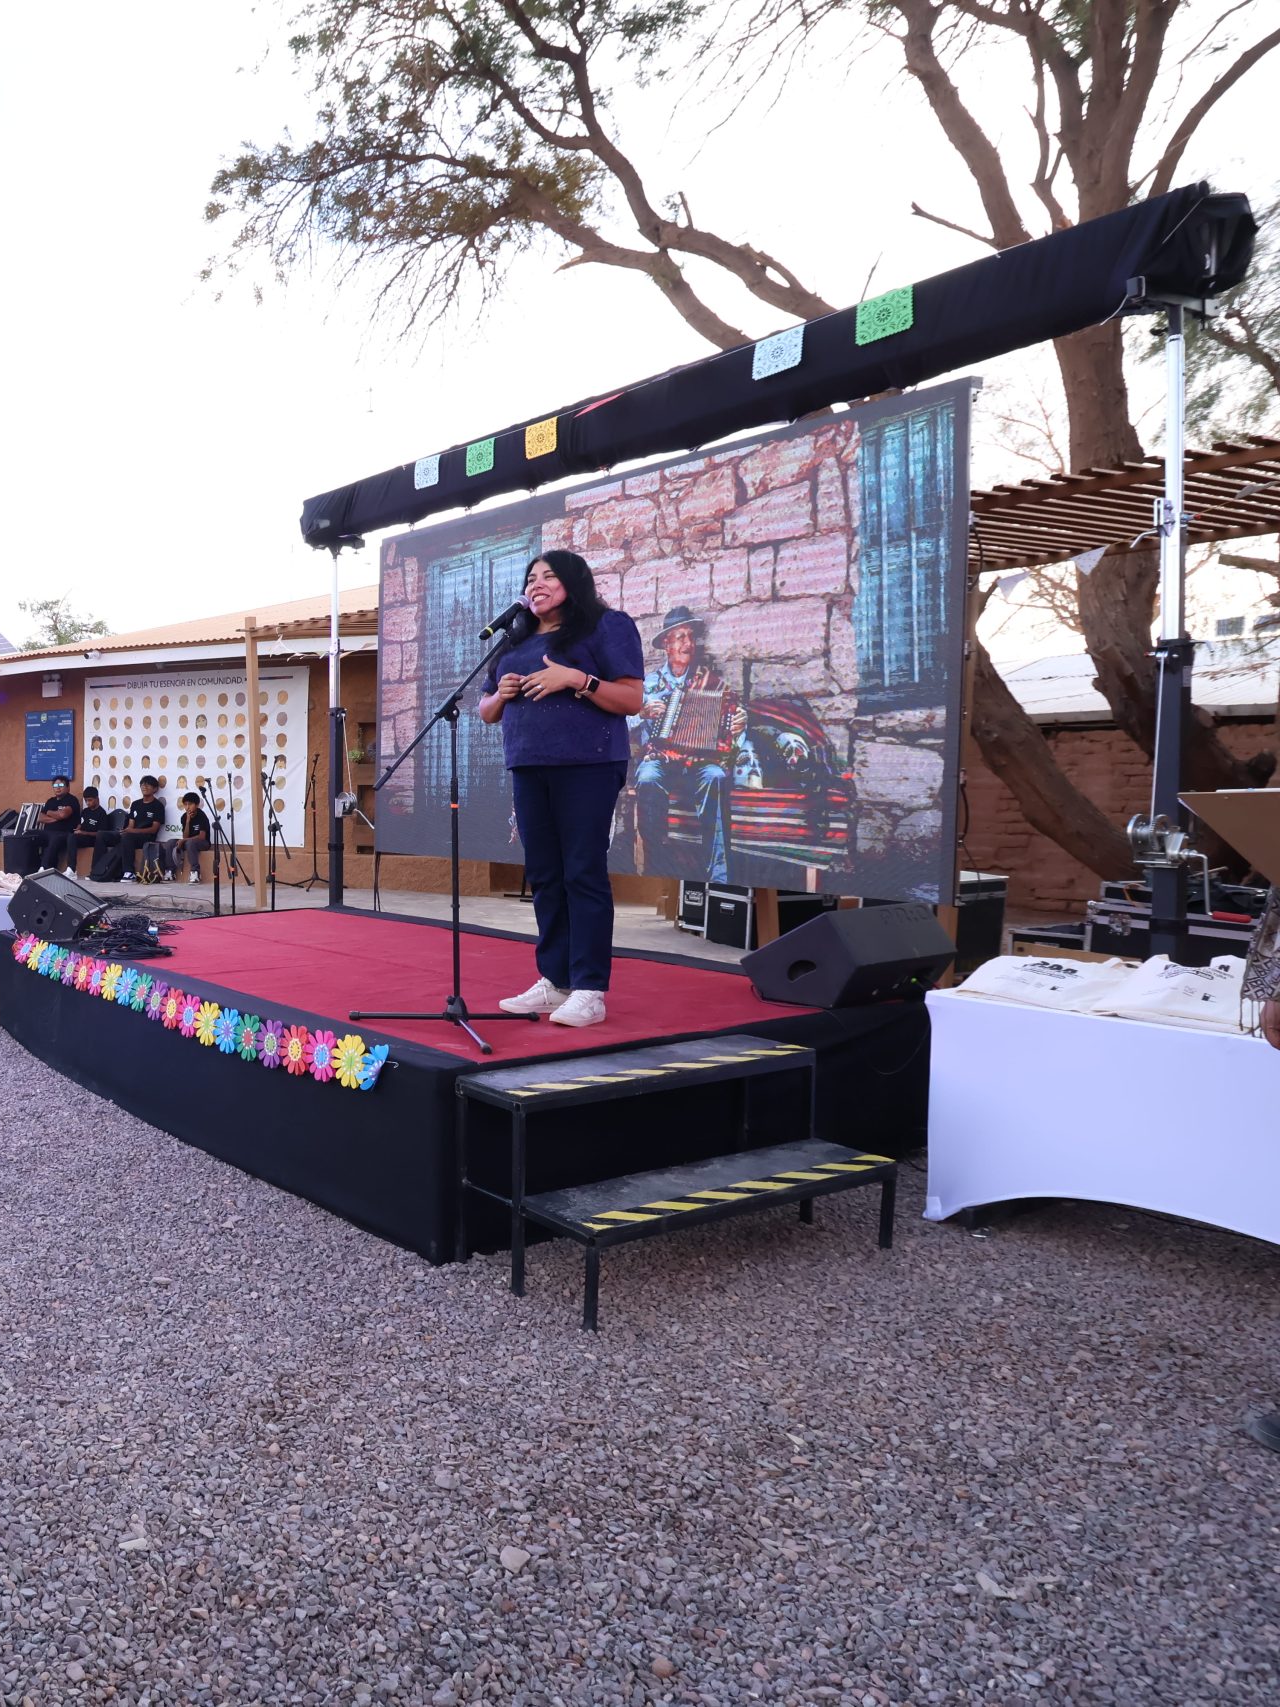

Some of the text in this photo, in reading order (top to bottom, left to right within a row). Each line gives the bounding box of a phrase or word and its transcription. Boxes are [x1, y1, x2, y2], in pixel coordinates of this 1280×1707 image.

[126, 681, 149, 690] DIBUJA
[149, 680, 159, 689] TU
[159, 679, 185, 688] ESENCIA
[187, 678, 196, 687] EN
[164, 824, 183, 833] SQM
